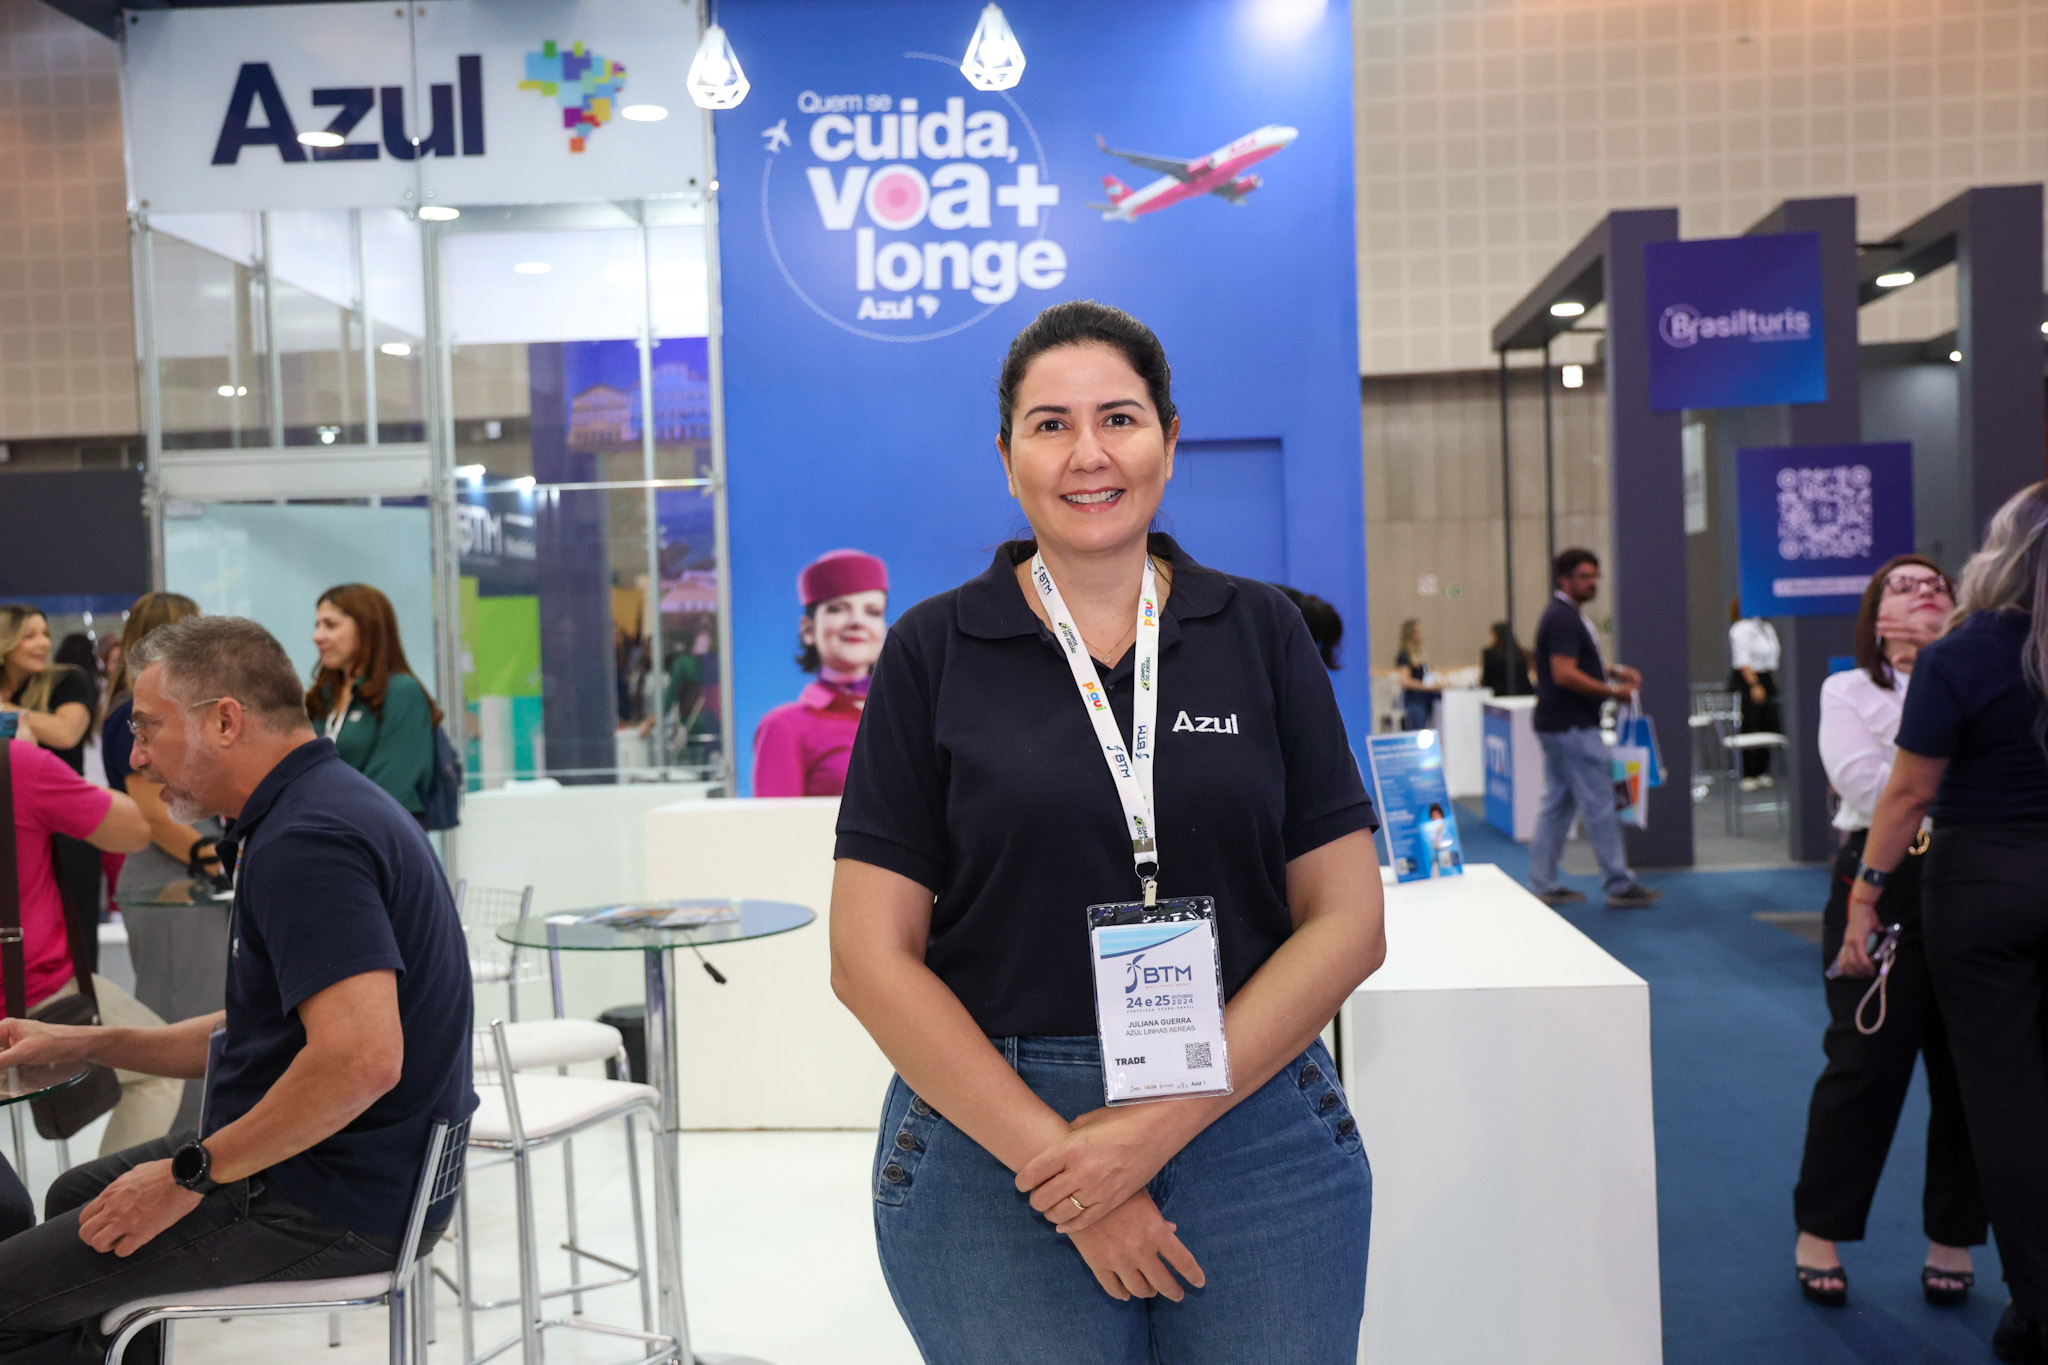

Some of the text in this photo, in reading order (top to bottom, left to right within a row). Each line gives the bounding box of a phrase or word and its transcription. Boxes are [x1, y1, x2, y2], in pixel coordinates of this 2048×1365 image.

[211, 54, 485, 165] Azul
[798, 90, 893, 114] Quem se
[809, 97, 1018, 163] cuida,
[856, 227, 1068, 305] longe
[857, 295, 914, 321] Azul
[1671, 307, 1812, 345] Brasilturis
[1039, 572, 1052, 595] BTM
[1066, 638, 1076, 654] JORDÃO
[1067, 629, 1078, 646] CAMPOS
[1172, 710, 1239, 735] Azul
[1137, 724, 1147, 751] BTM
[1114, 753, 1132, 779] BTM
[1143, 965, 1192, 983] BTM
[1126, 995, 1171, 1008] 24 e 25
[1125, 1024, 1196, 1037] AZUL LINHAS AEREAS
[1128, 1017, 1192, 1028] JULIANA GUERRA
[1115, 1056, 1146, 1066] TRADE
